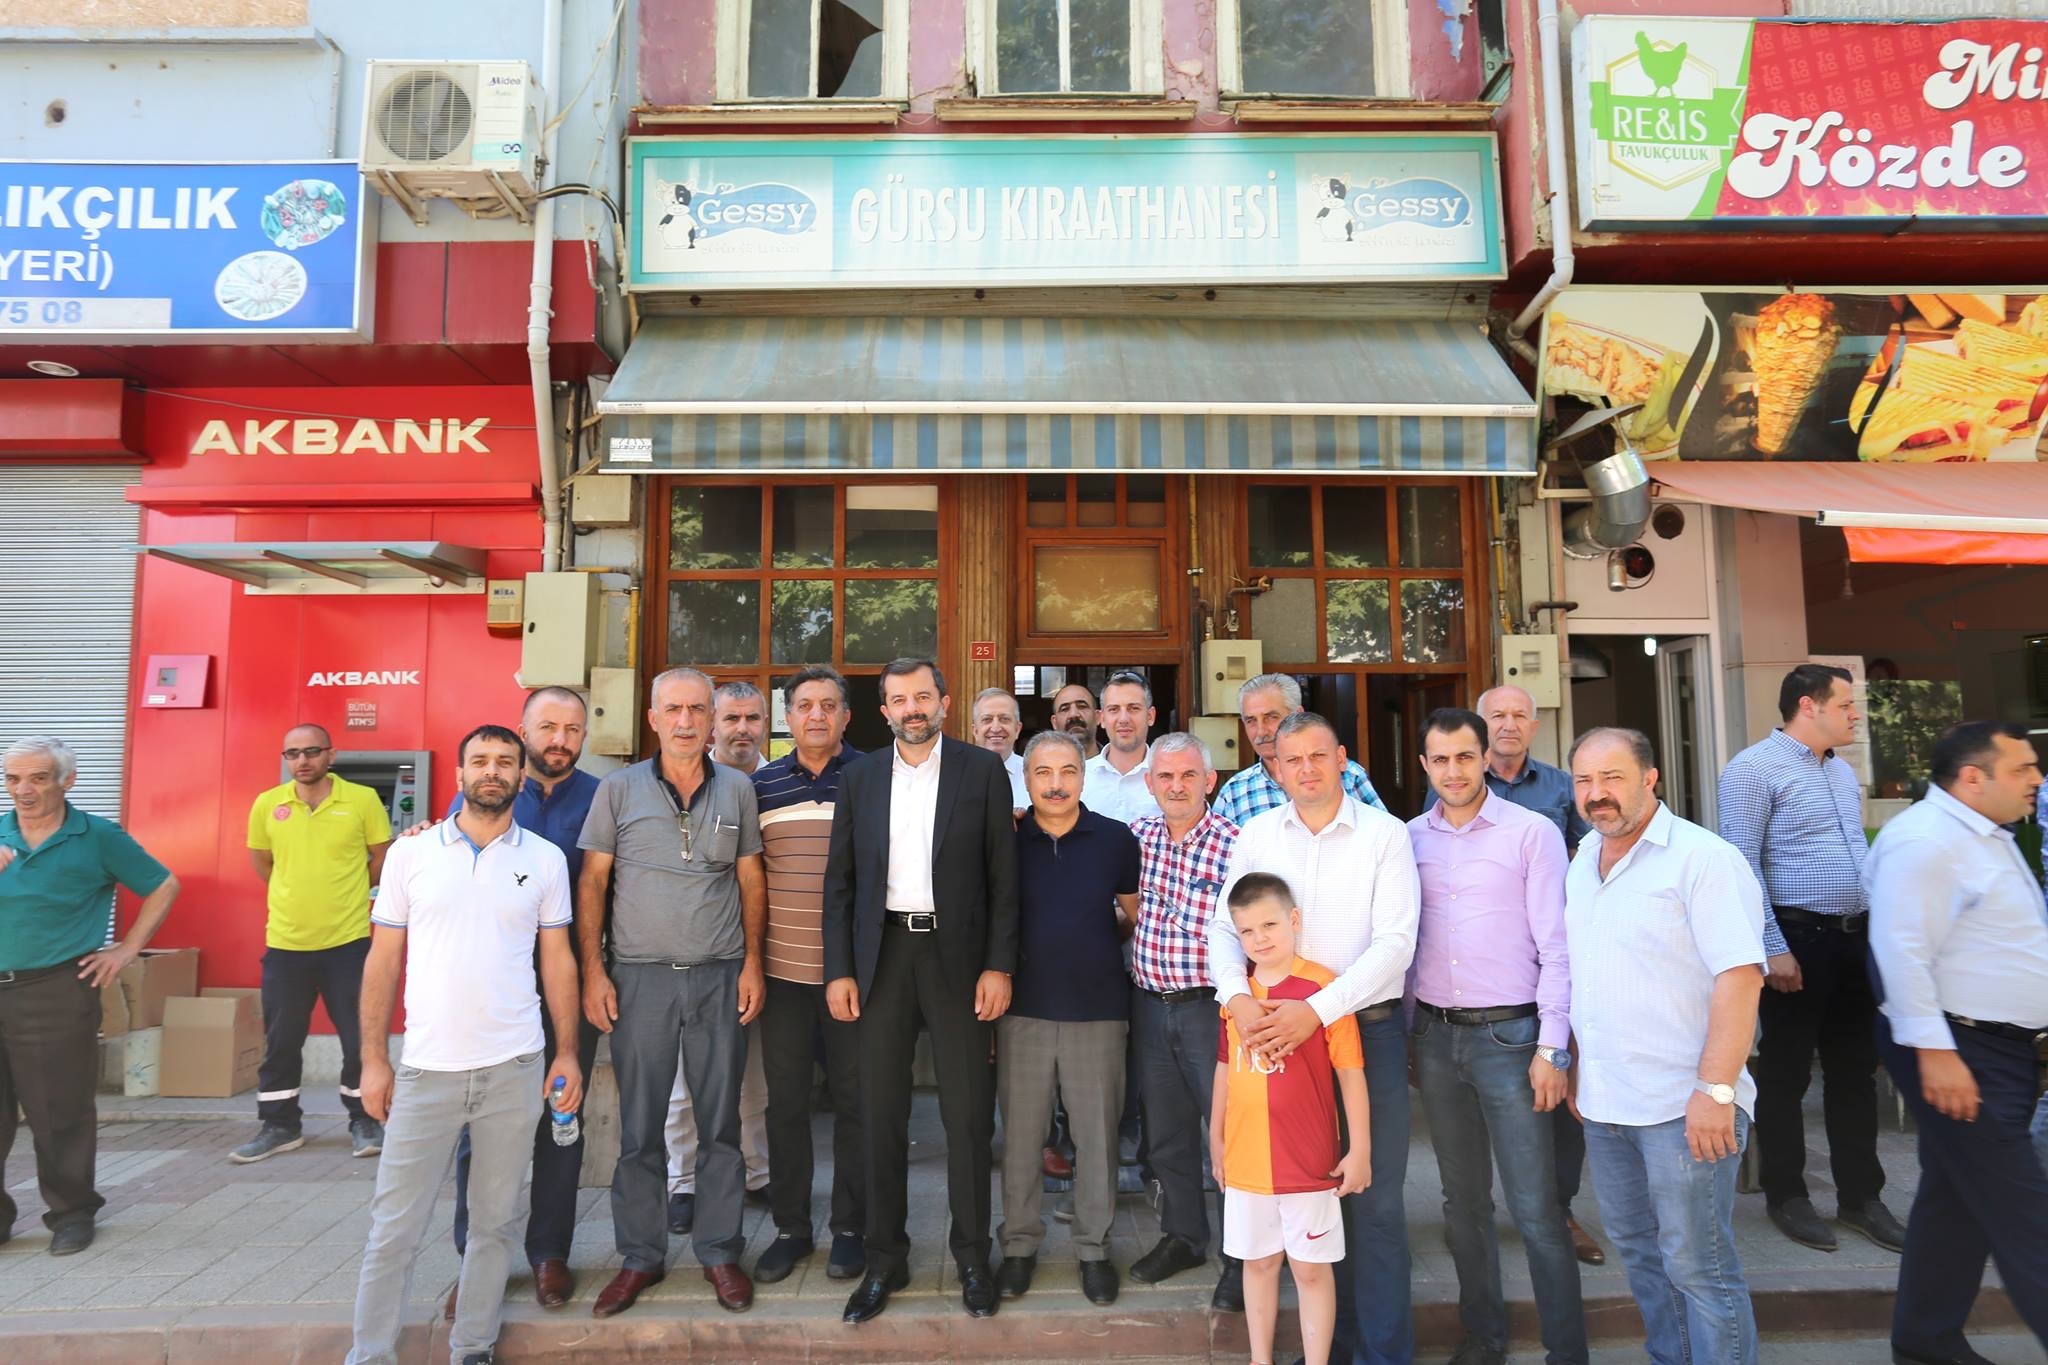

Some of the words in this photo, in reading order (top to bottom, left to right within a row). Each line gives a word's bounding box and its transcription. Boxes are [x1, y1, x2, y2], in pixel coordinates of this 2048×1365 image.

[1613, 100, 1708, 143] RE&İS
[1618, 144, 1710, 163] TAVUKÇULUK
[1727, 110, 2027, 199] Közde
[0, 185, 240, 240] IKÇILIK
[697, 198, 809, 231] Gessy
[850, 173, 986, 243] GÜRSU
[1003, 169, 1280, 241] KIRAATHANESİ
[1353, 192, 1463, 222] Gessy
[42, 300, 82, 324] 08
[191, 417, 490, 454] AKBANK
[976, 646, 990, 656] 25
[307, 670, 420, 687] AKBANK
